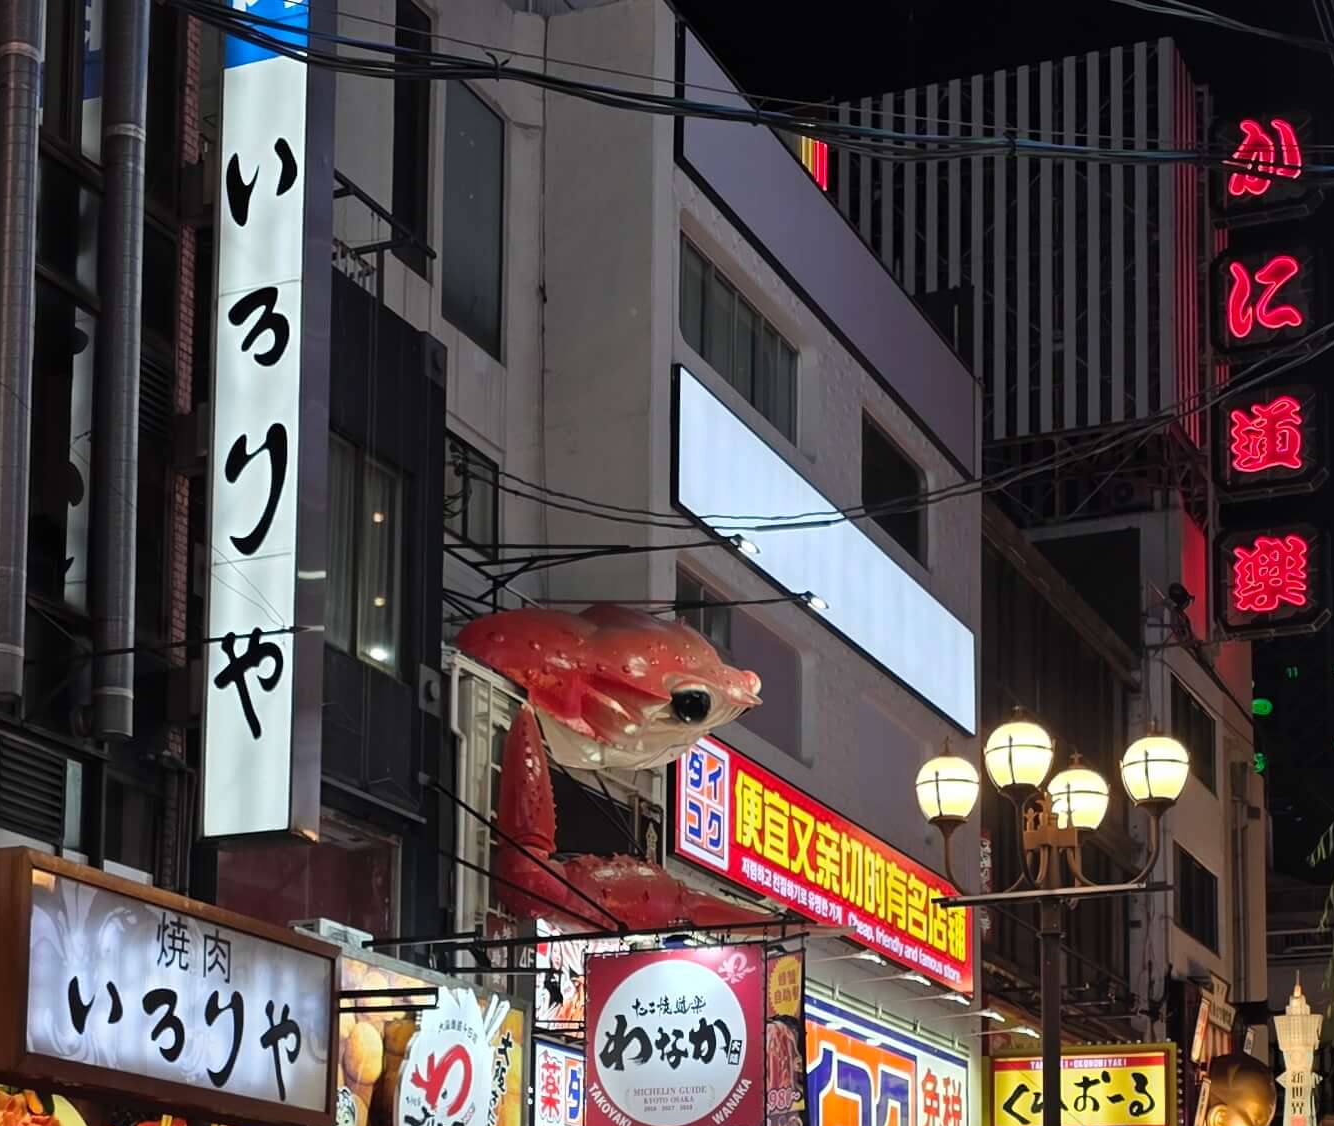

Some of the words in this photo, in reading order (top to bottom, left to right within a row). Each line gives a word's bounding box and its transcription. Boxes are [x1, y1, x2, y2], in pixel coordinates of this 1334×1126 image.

[213, 136, 299, 740] いろりや
[156, 910, 233, 984] 焼肉
[67, 975, 303, 1101] いろりや
[598, 1013, 732, 1072] わなか
[633, 1087, 677, 1097] MICHELIN
[678, 1085, 708, 1095] GUIDE
[711, 1077, 753, 1126] WANAKA
